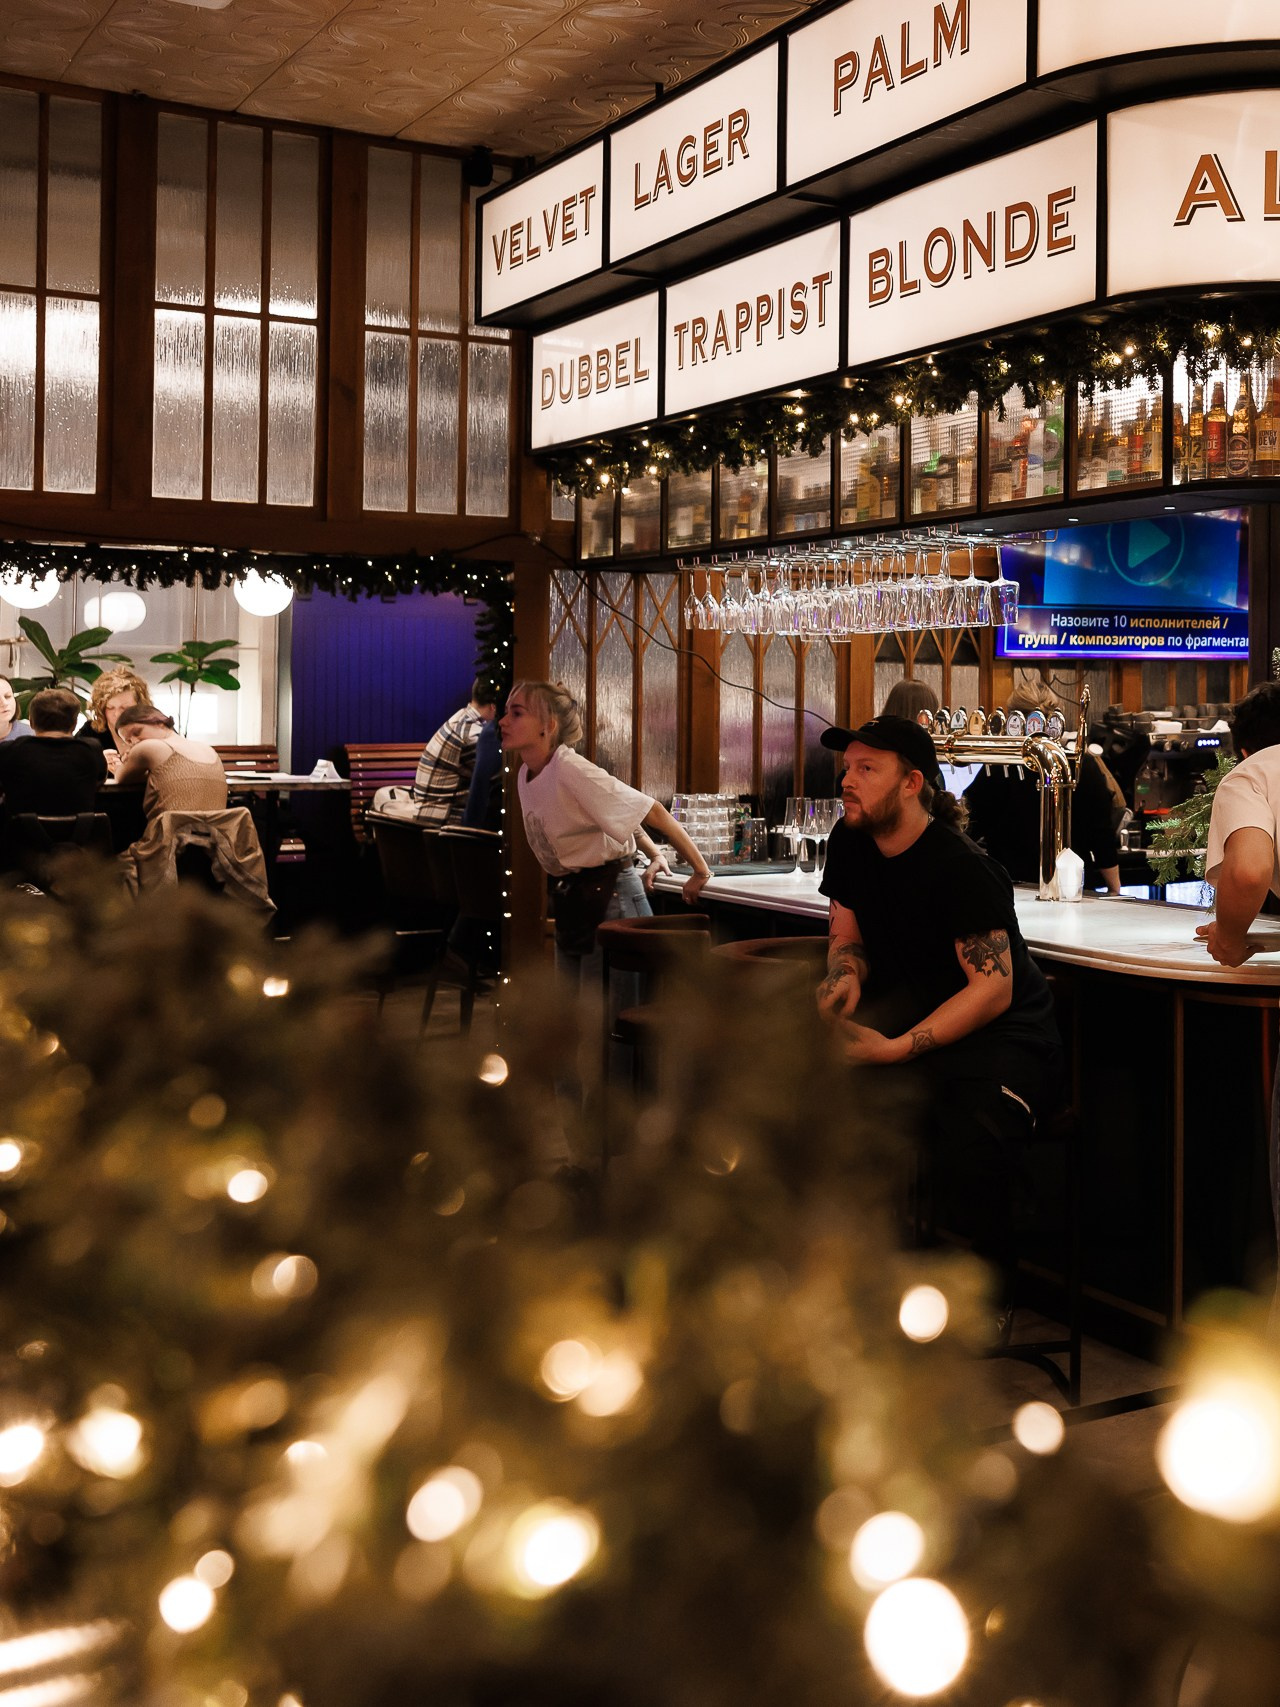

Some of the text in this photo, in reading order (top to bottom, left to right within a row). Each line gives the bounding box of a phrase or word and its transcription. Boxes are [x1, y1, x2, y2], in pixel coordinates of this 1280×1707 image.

[833, 0, 970, 118] PALM
[633, 107, 750, 211] LAGER
[491, 184, 597, 276] VELVET
[867, 185, 1076, 308] BLONDE
[673, 270, 833, 370] TRAPPIST
[541, 335, 650, 410] DUBBEL
[1018, 633, 1058, 648] групп
[1069, 634, 1165, 649] композиторов
[1167, 636, 1183, 647] по
[1050, 614, 1110, 628] Назовите
[1113, 615, 1127, 628] 10
[1130, 615, 1221, 629] исполнителей
